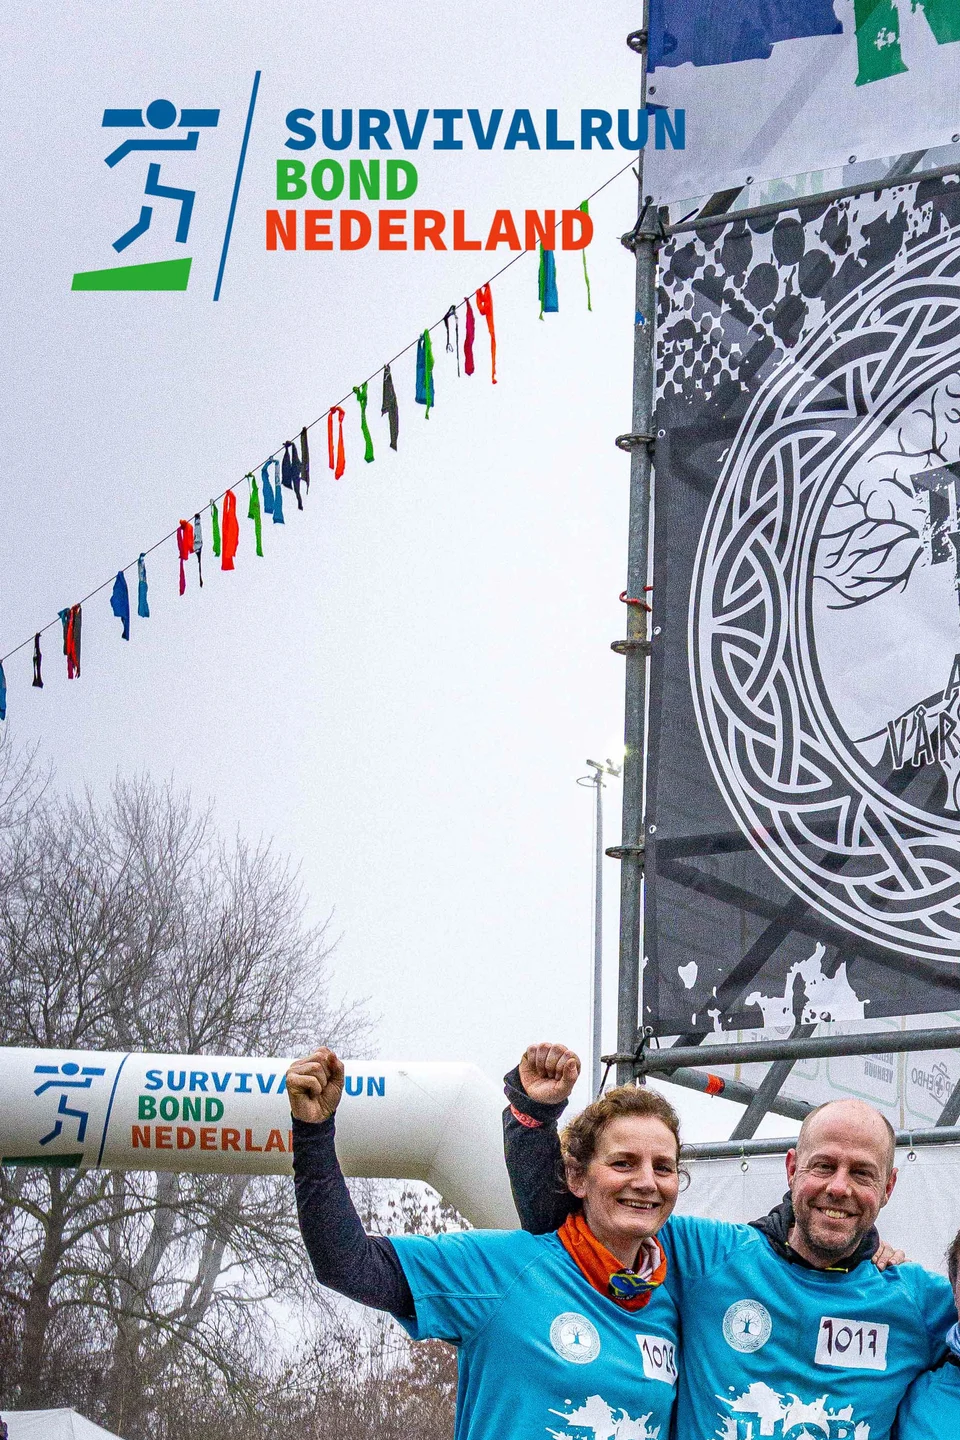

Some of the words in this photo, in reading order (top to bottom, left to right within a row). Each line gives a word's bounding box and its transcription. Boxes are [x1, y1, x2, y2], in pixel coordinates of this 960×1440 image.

[145, 1069, 386, 1097] SURVIVUN
[138, 1094, 225, 1122] BOND
[131, 1125, 294, 1153] NEDERLA
[822, 1319, 877, 1357] 1017
